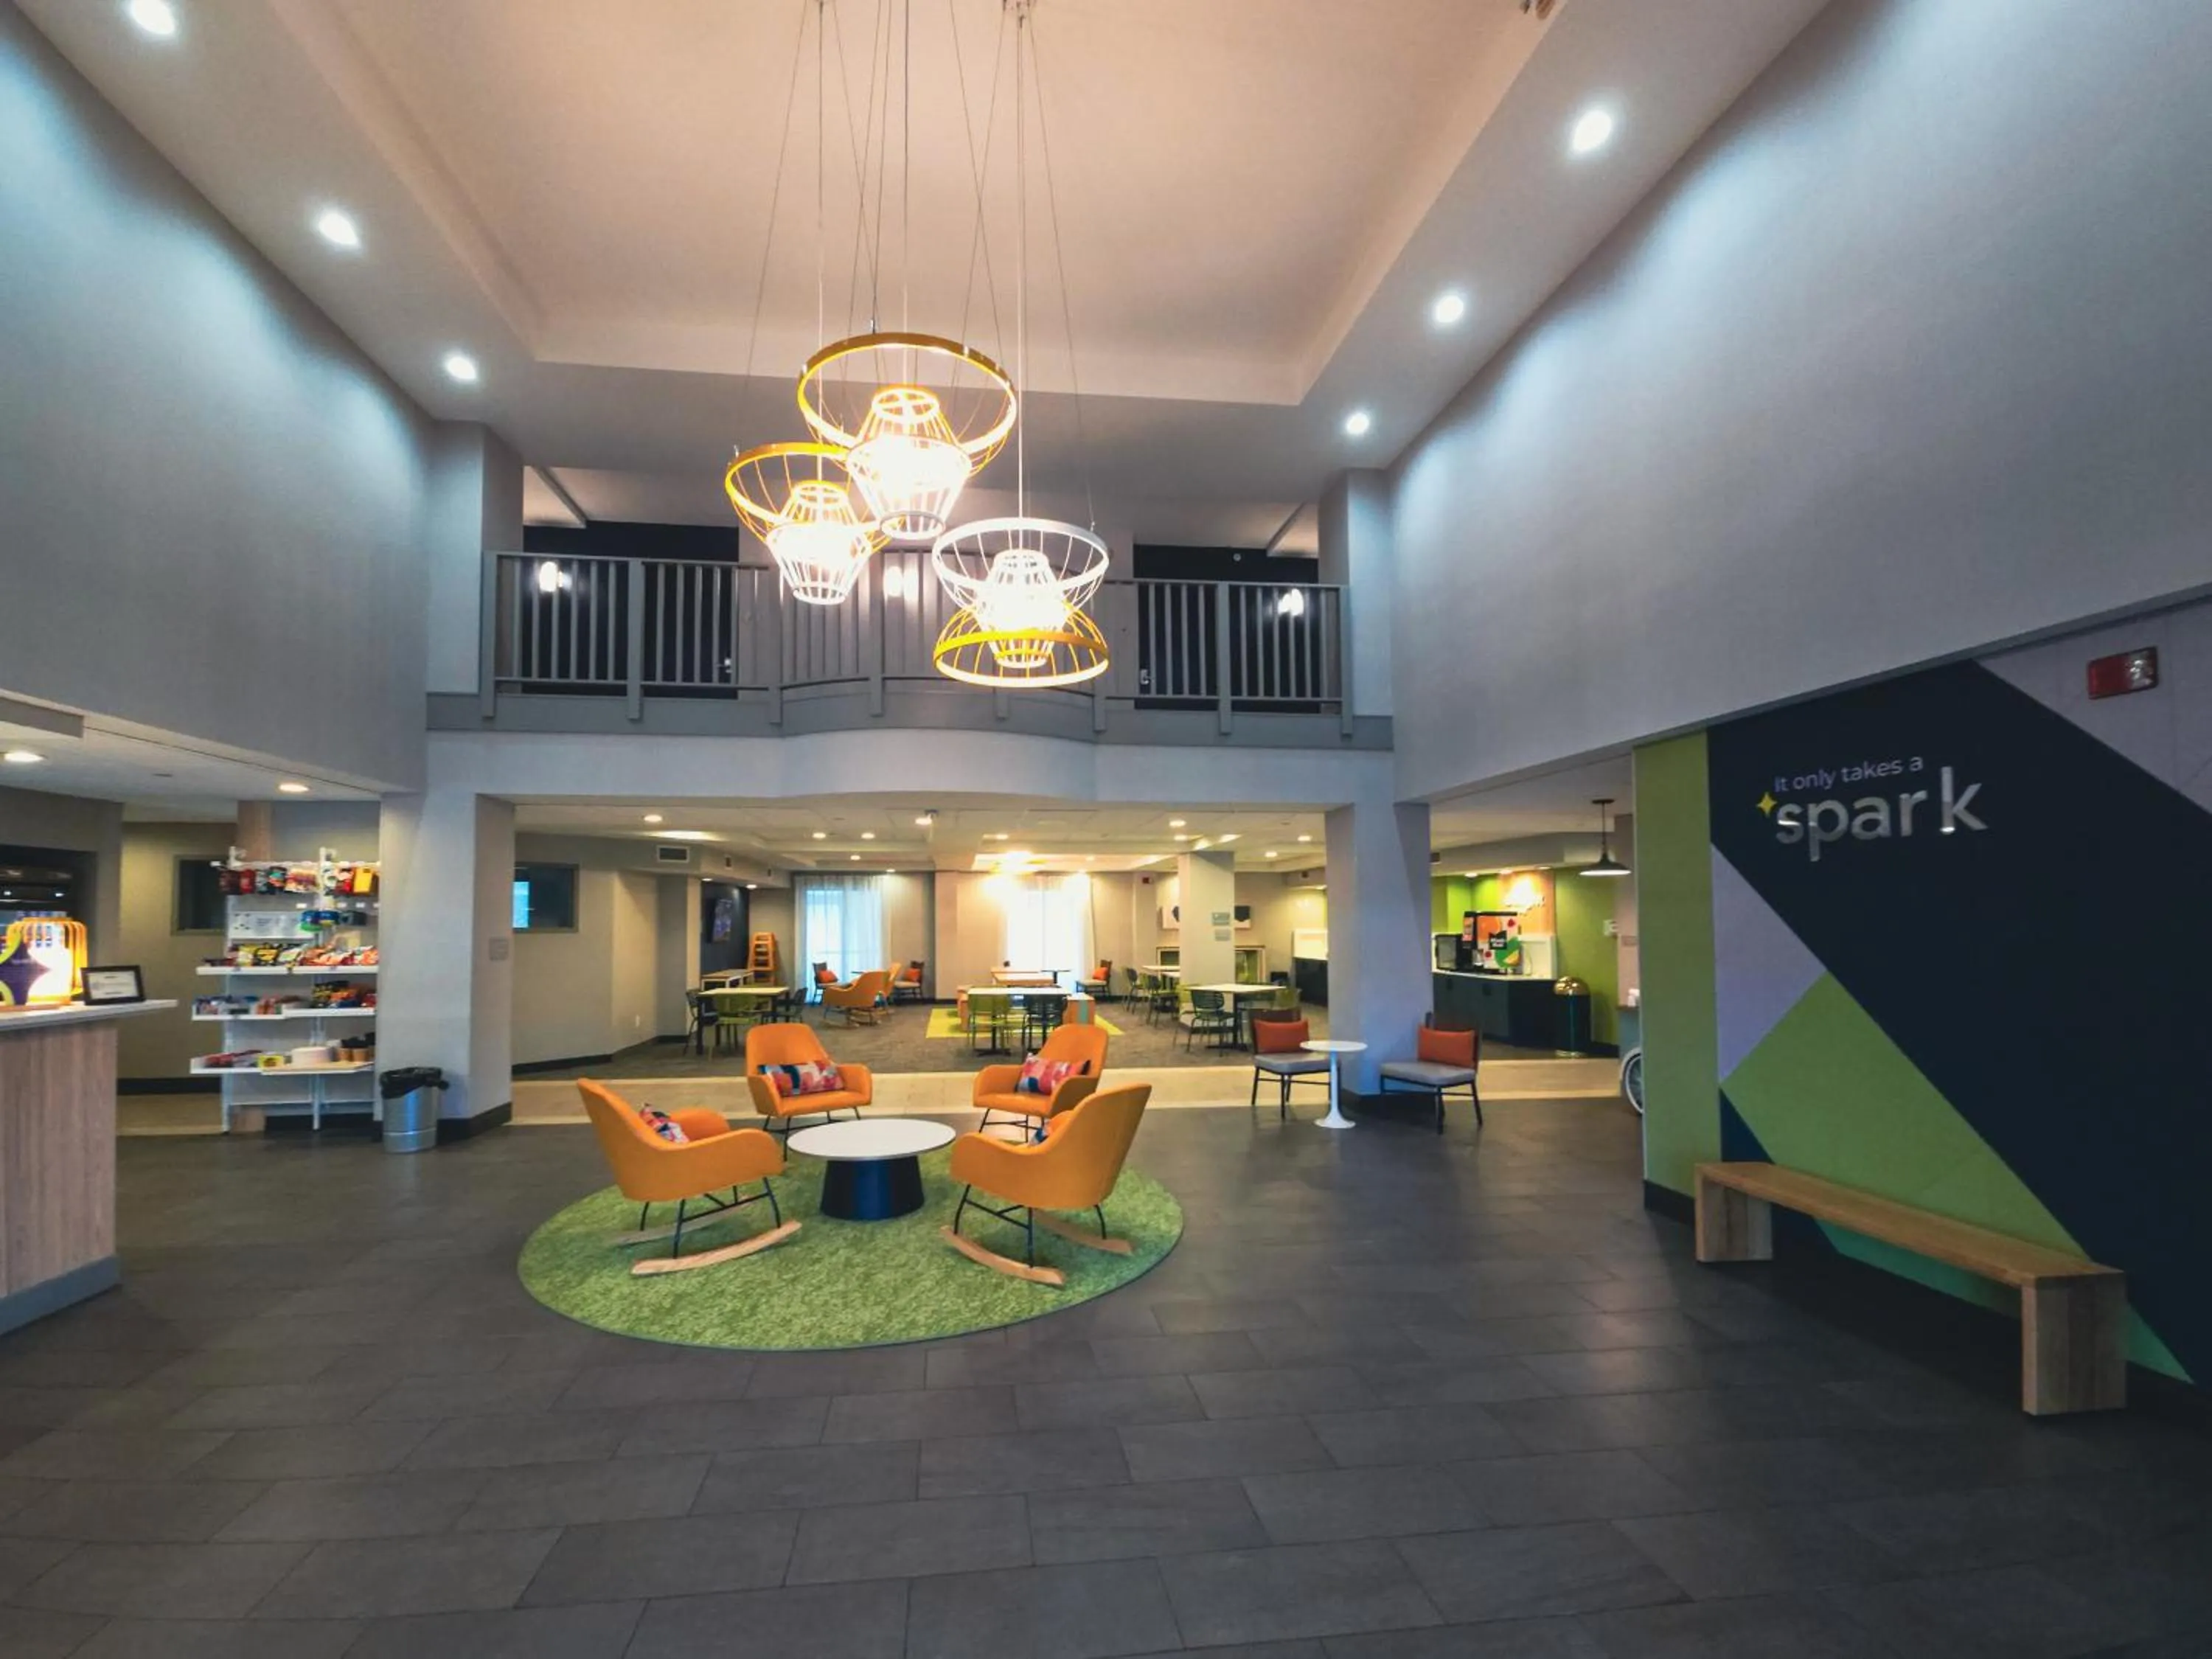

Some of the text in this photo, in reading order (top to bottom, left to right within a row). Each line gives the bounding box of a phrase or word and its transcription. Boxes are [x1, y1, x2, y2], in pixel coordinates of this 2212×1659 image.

[1792, 769, 1836, 790] only
[1841, 761, 1902, 782] takes
[1909, 757, 1924, 771] a
[1776, 766, 1989, 861] spark
